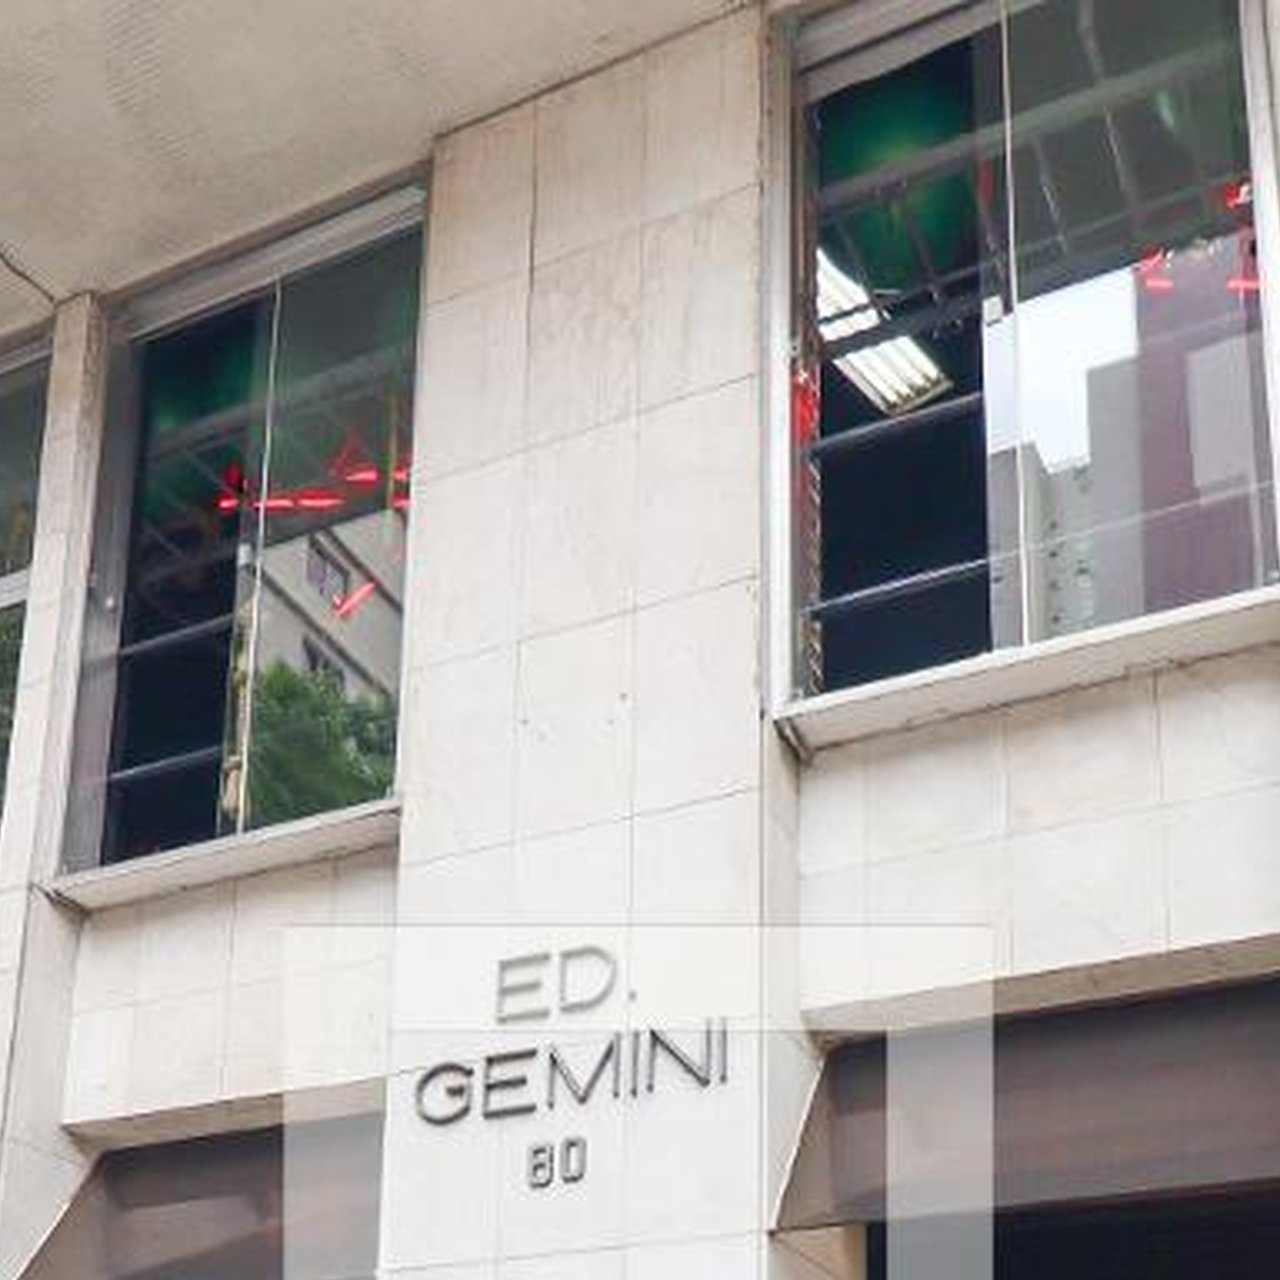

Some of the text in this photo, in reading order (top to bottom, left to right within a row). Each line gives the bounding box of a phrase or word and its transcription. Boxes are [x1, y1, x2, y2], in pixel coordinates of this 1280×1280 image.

[495, 944, 637, 1026] ED.
[414, 1016, 729, 1127] GEMINI
[526, 1137, 588, 1190] 80
